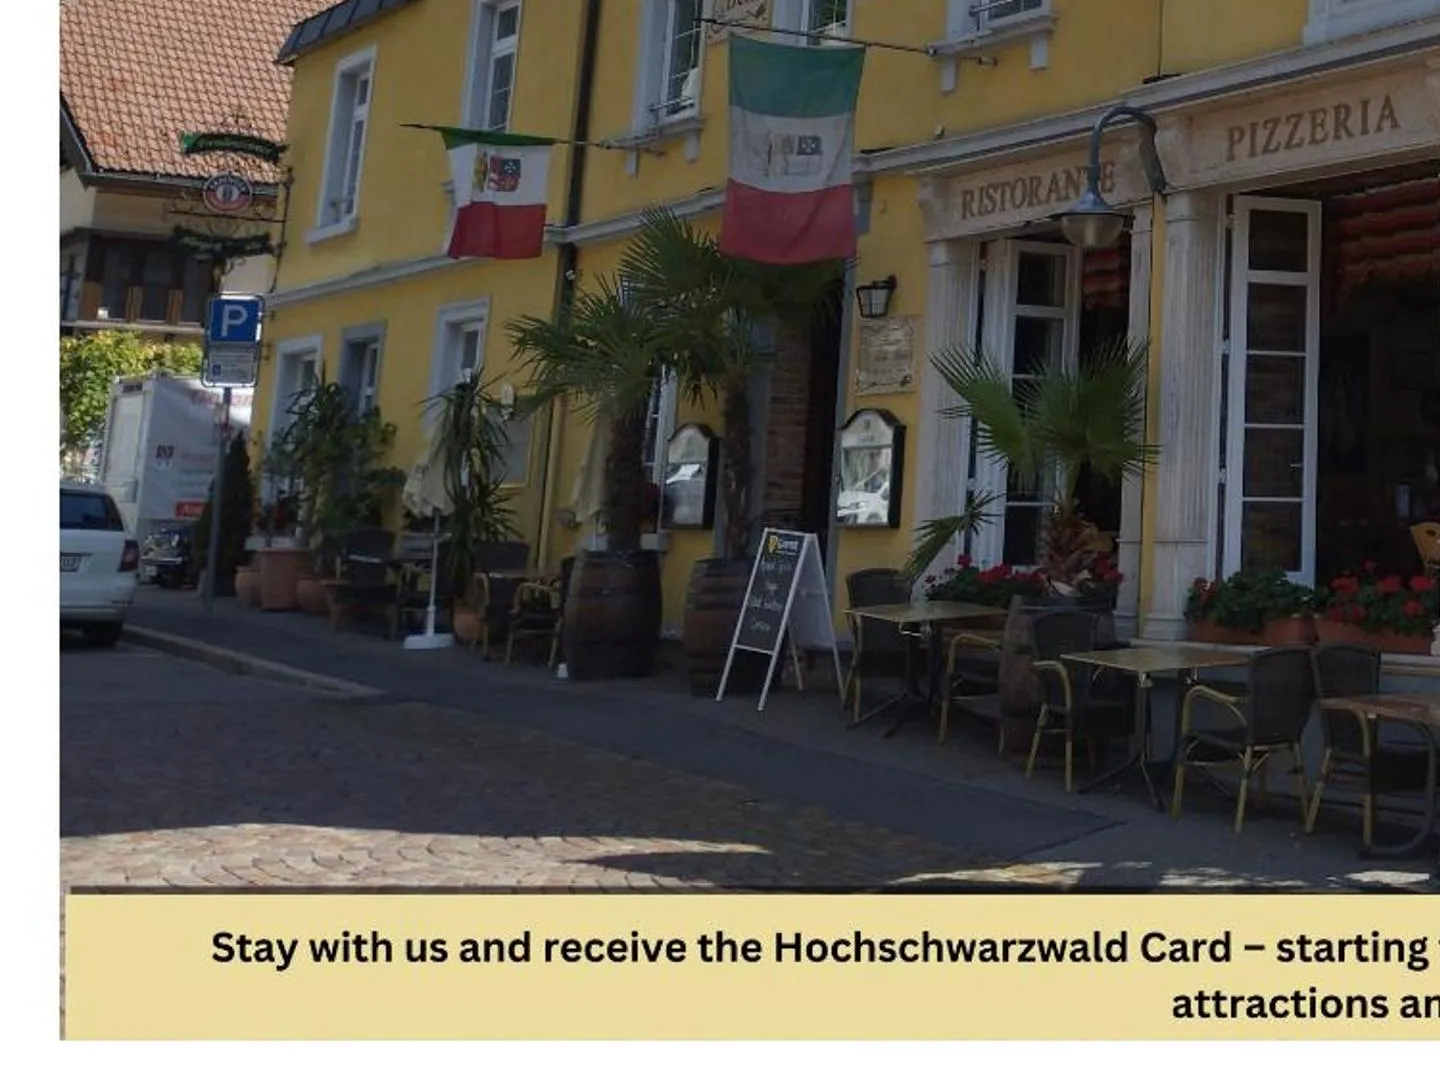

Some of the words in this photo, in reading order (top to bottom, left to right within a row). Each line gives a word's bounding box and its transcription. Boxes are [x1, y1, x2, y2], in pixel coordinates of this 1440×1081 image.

[1226, 93, 1402, 162] PIZZERIA
[961, 160, 1116, 219] RISTORANE
[222, 304, 248, 337] P
